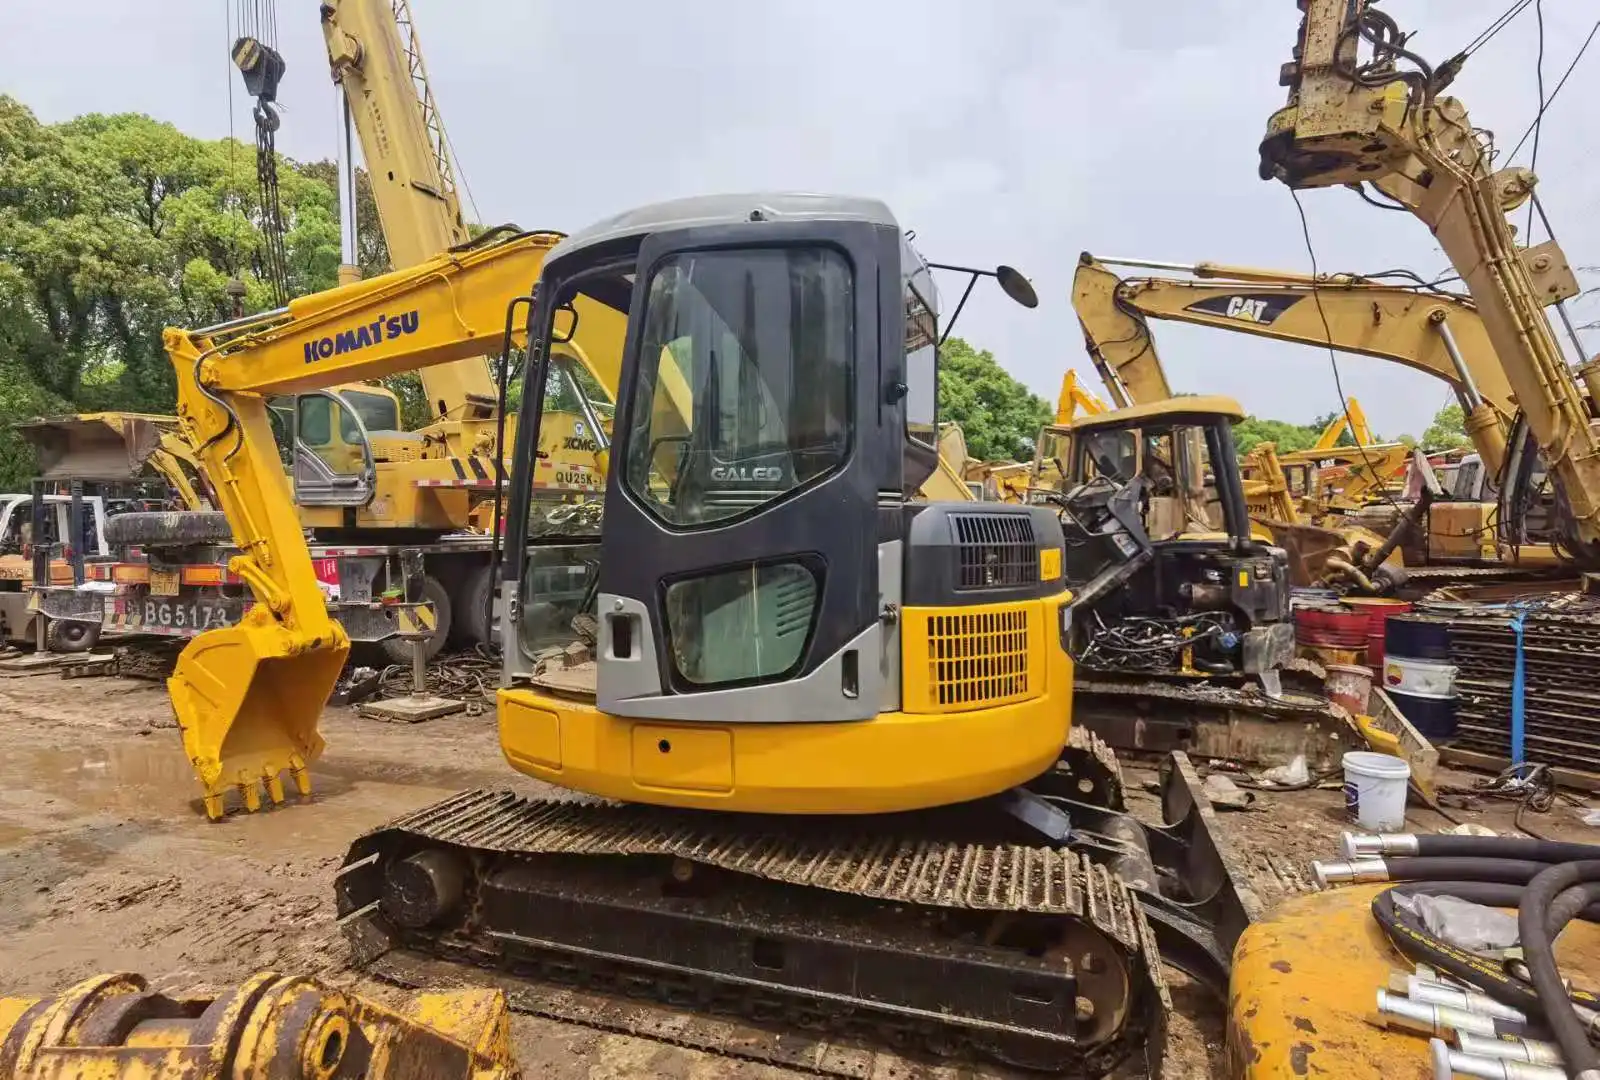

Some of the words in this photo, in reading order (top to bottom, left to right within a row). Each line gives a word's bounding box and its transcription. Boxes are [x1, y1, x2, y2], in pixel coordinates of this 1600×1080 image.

[1226, 296, 1267, 322] CAT
[303, 310, 419, 364] KOMATSU
[710, 467, 783, 482] GALEO
